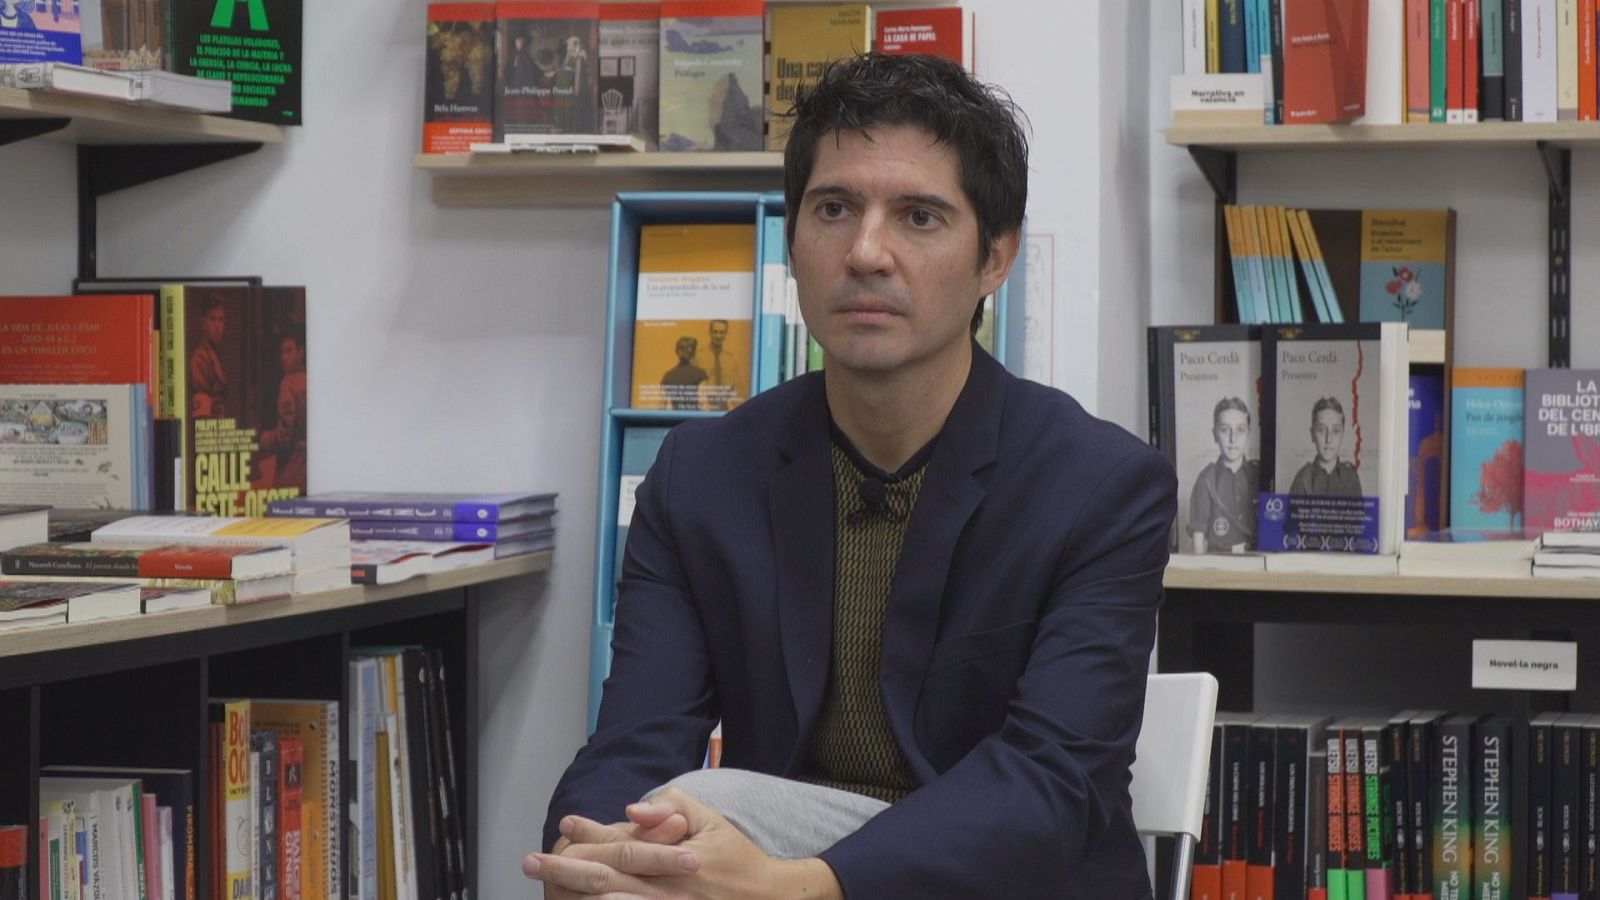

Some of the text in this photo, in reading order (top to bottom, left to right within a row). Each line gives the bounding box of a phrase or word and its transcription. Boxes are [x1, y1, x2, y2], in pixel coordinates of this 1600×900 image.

[200, 34, 210, 43] LOS
[211, 35, 242, 45] PLATILLOS
[884, 32, 936, 43] LA CASA DE PAPEL
[777, 58, 802, 78] Una
[1191, 89, 1234, 97] Narrativa
[1180, 350, 1240, 364] Paco Cerdà
[1282, 350, 1337, 364] Paco Cerdà
[1180, 371, 1219, 381] Presentes
[1282, 370, 1318, 380] Presentes
[1577, 380, 1597, 393] LA
[1538, 408, 1568, 422] DEL
[1547, 423, 1568, 436] DE
[195, 453, 251, 492] CALLE
[1489, 658, 1559, 671] Novel·la negra
[1327, 738, 1342, 851] UKETSU STRANGE HOUSES
[1345, 738, 1361, 851] UKETSU STRANGE HOUSES
[1364, 739, 1380, 860] UKETSU STRANGE PICTURES
[1442, 735, 1458, 863] STEPHEN KING
[1484, 735, 1499, 864] STEPHEN KING
[328, 760, 337, 895] MONSTRUOS
[92, 823, 100, 866] MARCOS
[1449, 871, 1458, 886] NO
[1491, 871, 1499, 887] NO
